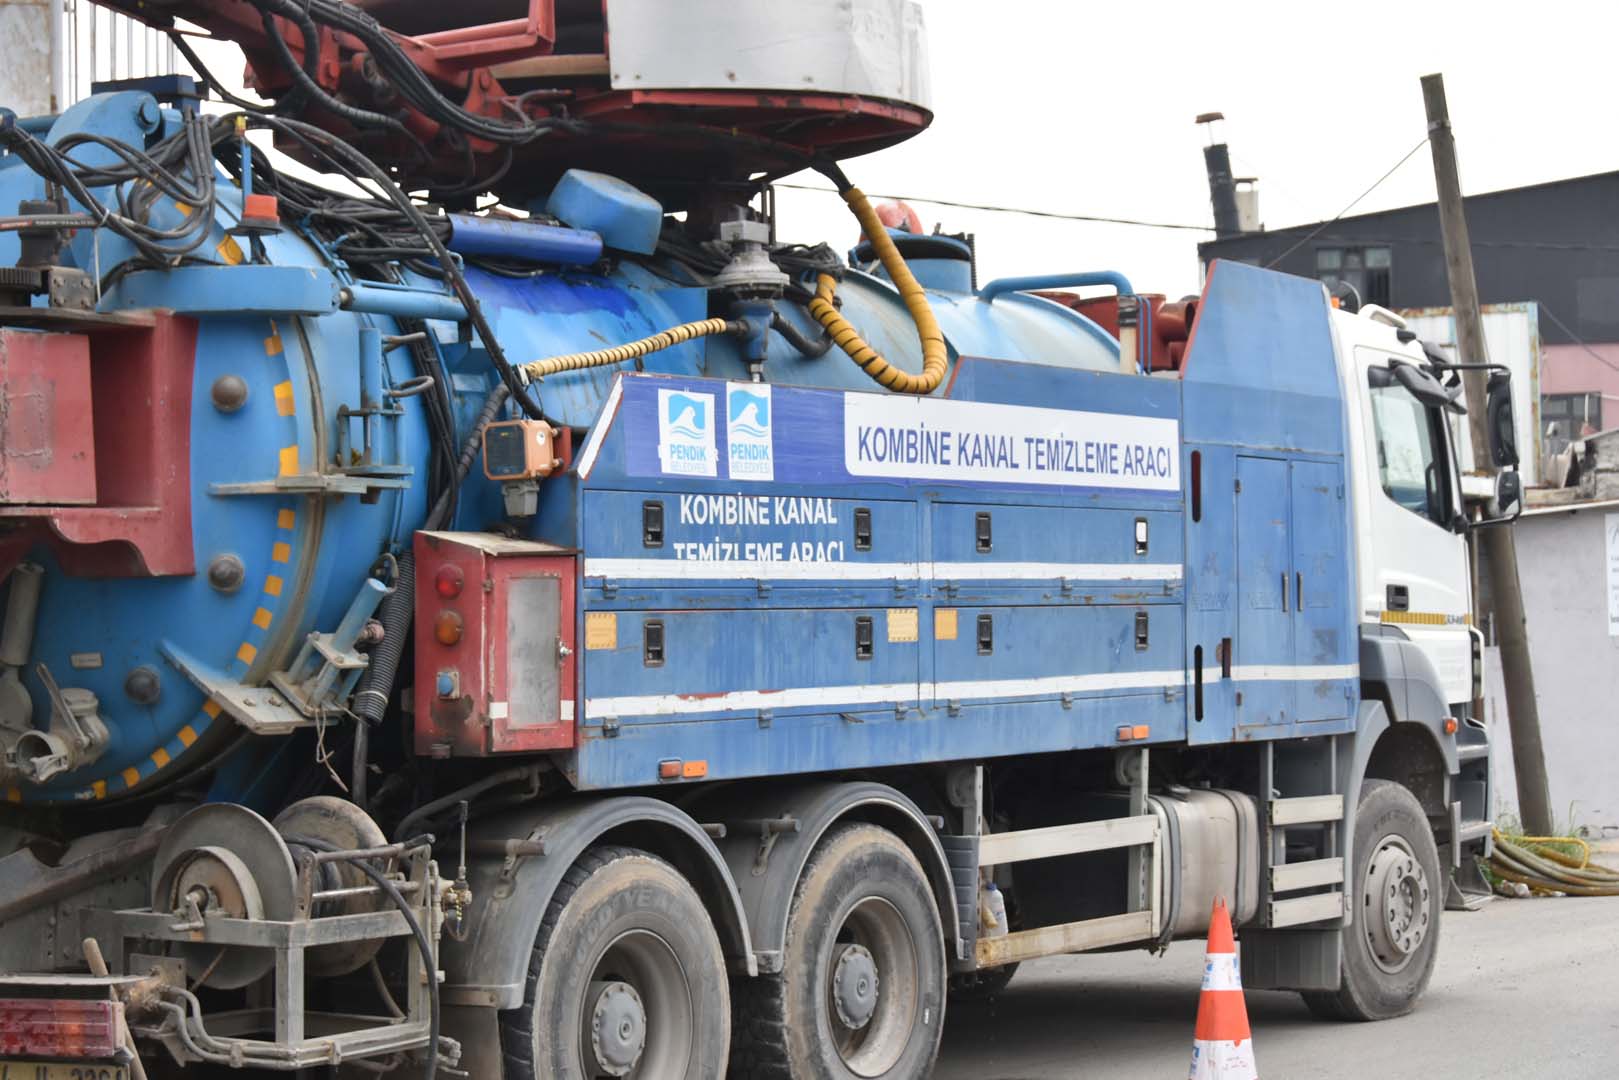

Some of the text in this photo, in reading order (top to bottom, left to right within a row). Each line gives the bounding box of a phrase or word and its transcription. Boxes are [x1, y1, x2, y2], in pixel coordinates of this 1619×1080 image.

[858, 422, 1171, 478] KOMBİNE KANAL TEMİZLEME ARACI
[680, 491, 838, 525] KOMBİNE KANAL
